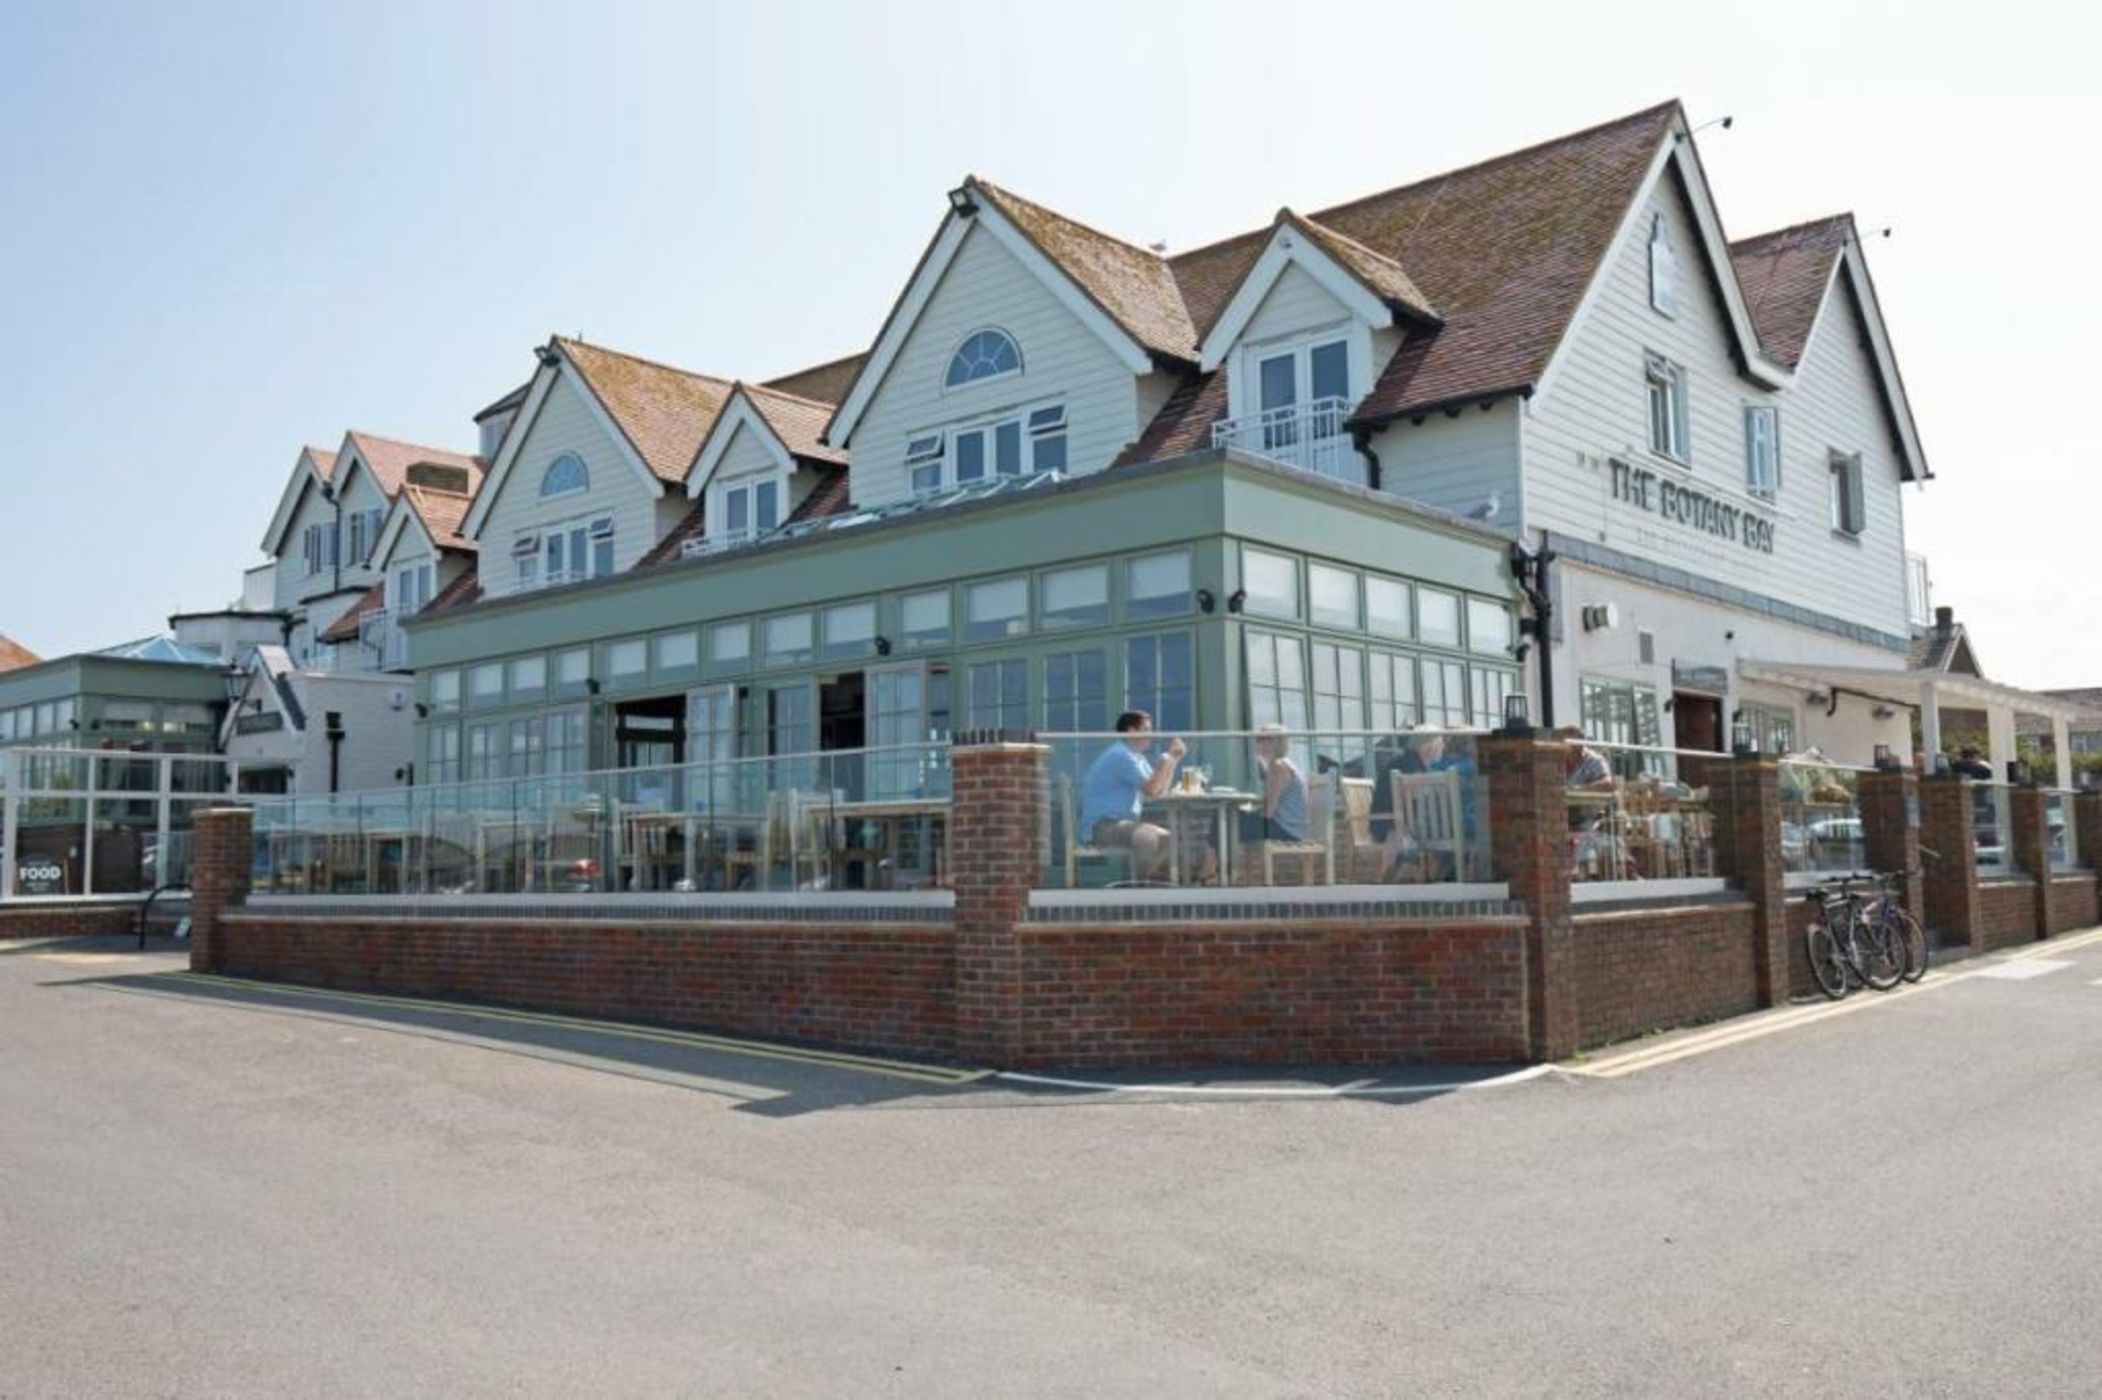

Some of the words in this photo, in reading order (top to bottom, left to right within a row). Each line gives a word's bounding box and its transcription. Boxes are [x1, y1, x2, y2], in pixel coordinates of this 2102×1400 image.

[1609, 457, 1655, 511] THE
[1660, 479, 1741, 540] BOTANY
[1742, 512, 1775, 554] BAY
[20, 865, 61, 880] FOOD
